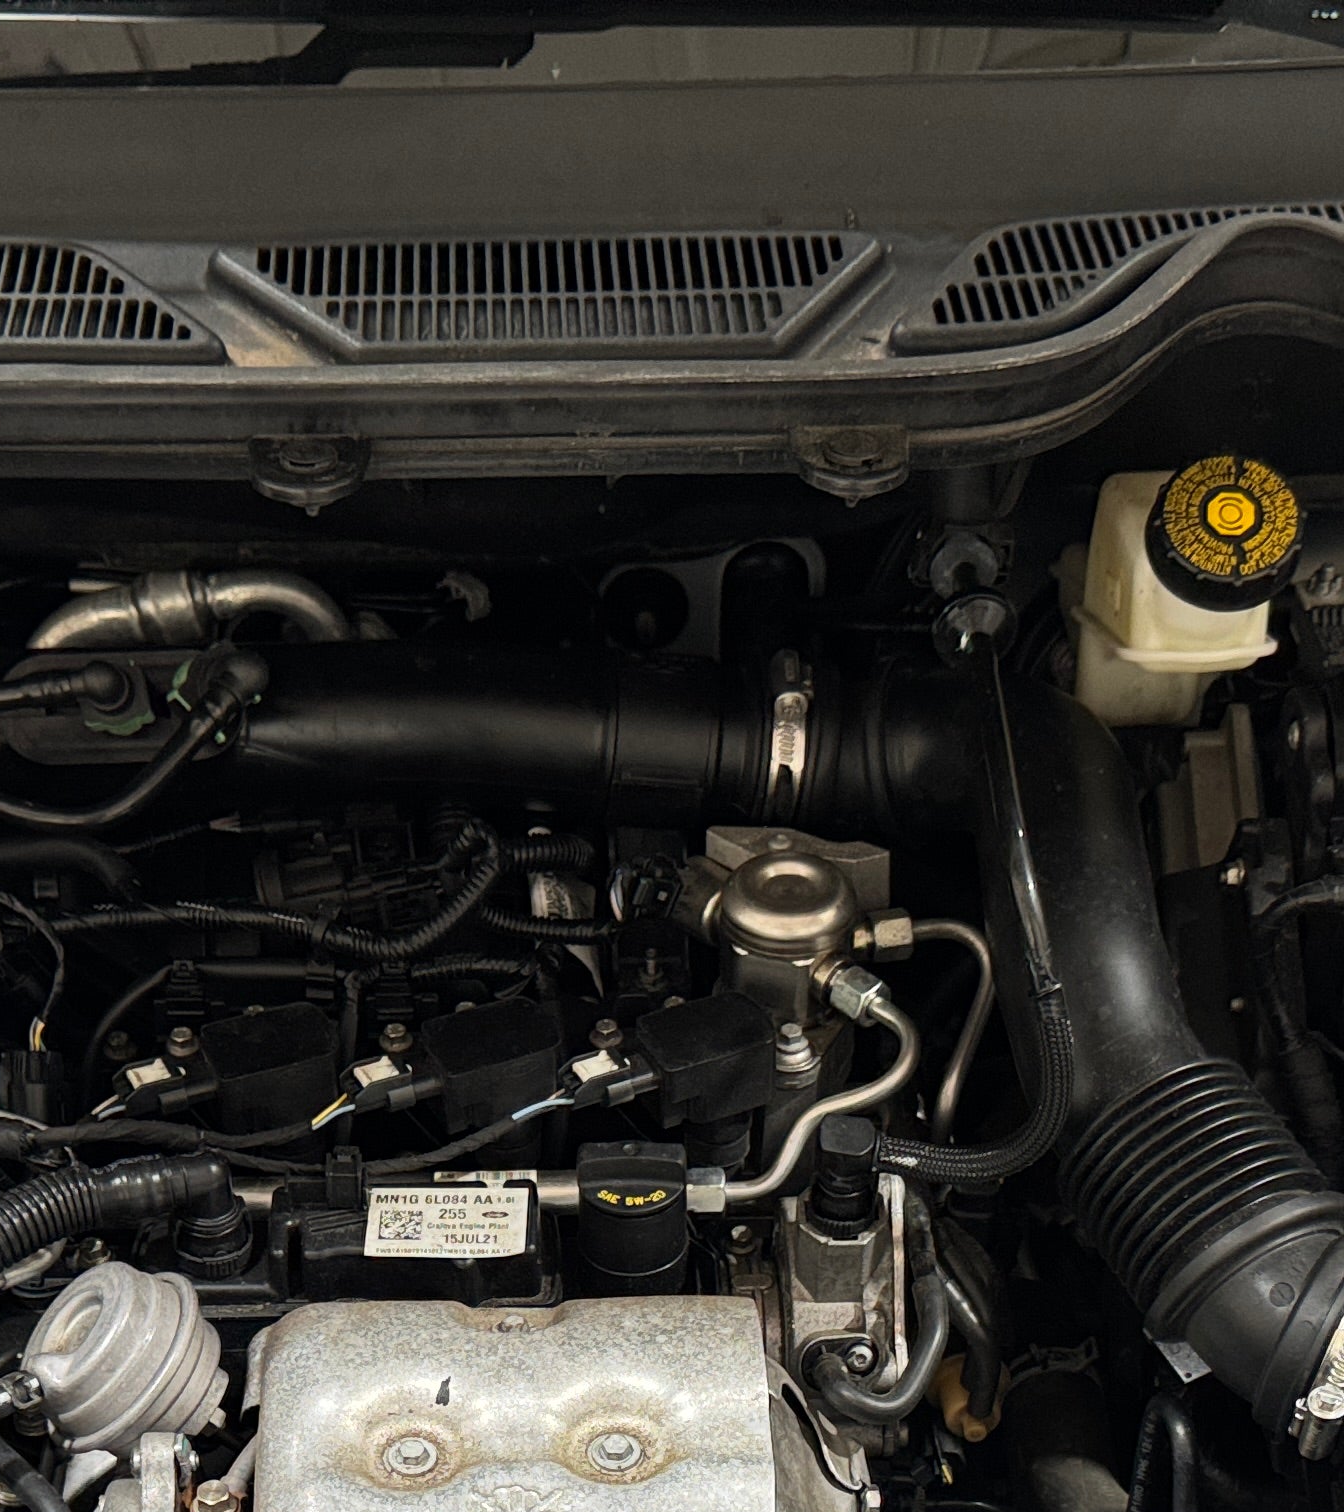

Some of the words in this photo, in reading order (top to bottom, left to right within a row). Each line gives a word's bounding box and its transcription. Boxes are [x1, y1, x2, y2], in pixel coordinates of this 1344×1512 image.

[375, 1194, 419, 1205] MN1G
[424, 1194, 468, 1205] 6L084
[473, 1194, 493, 1205] AA
[597, 1189, 621, 1205] SAE
[438, 1208, 467, 1220] 255
[444, 1234, 498, 1245] 15JUL21
